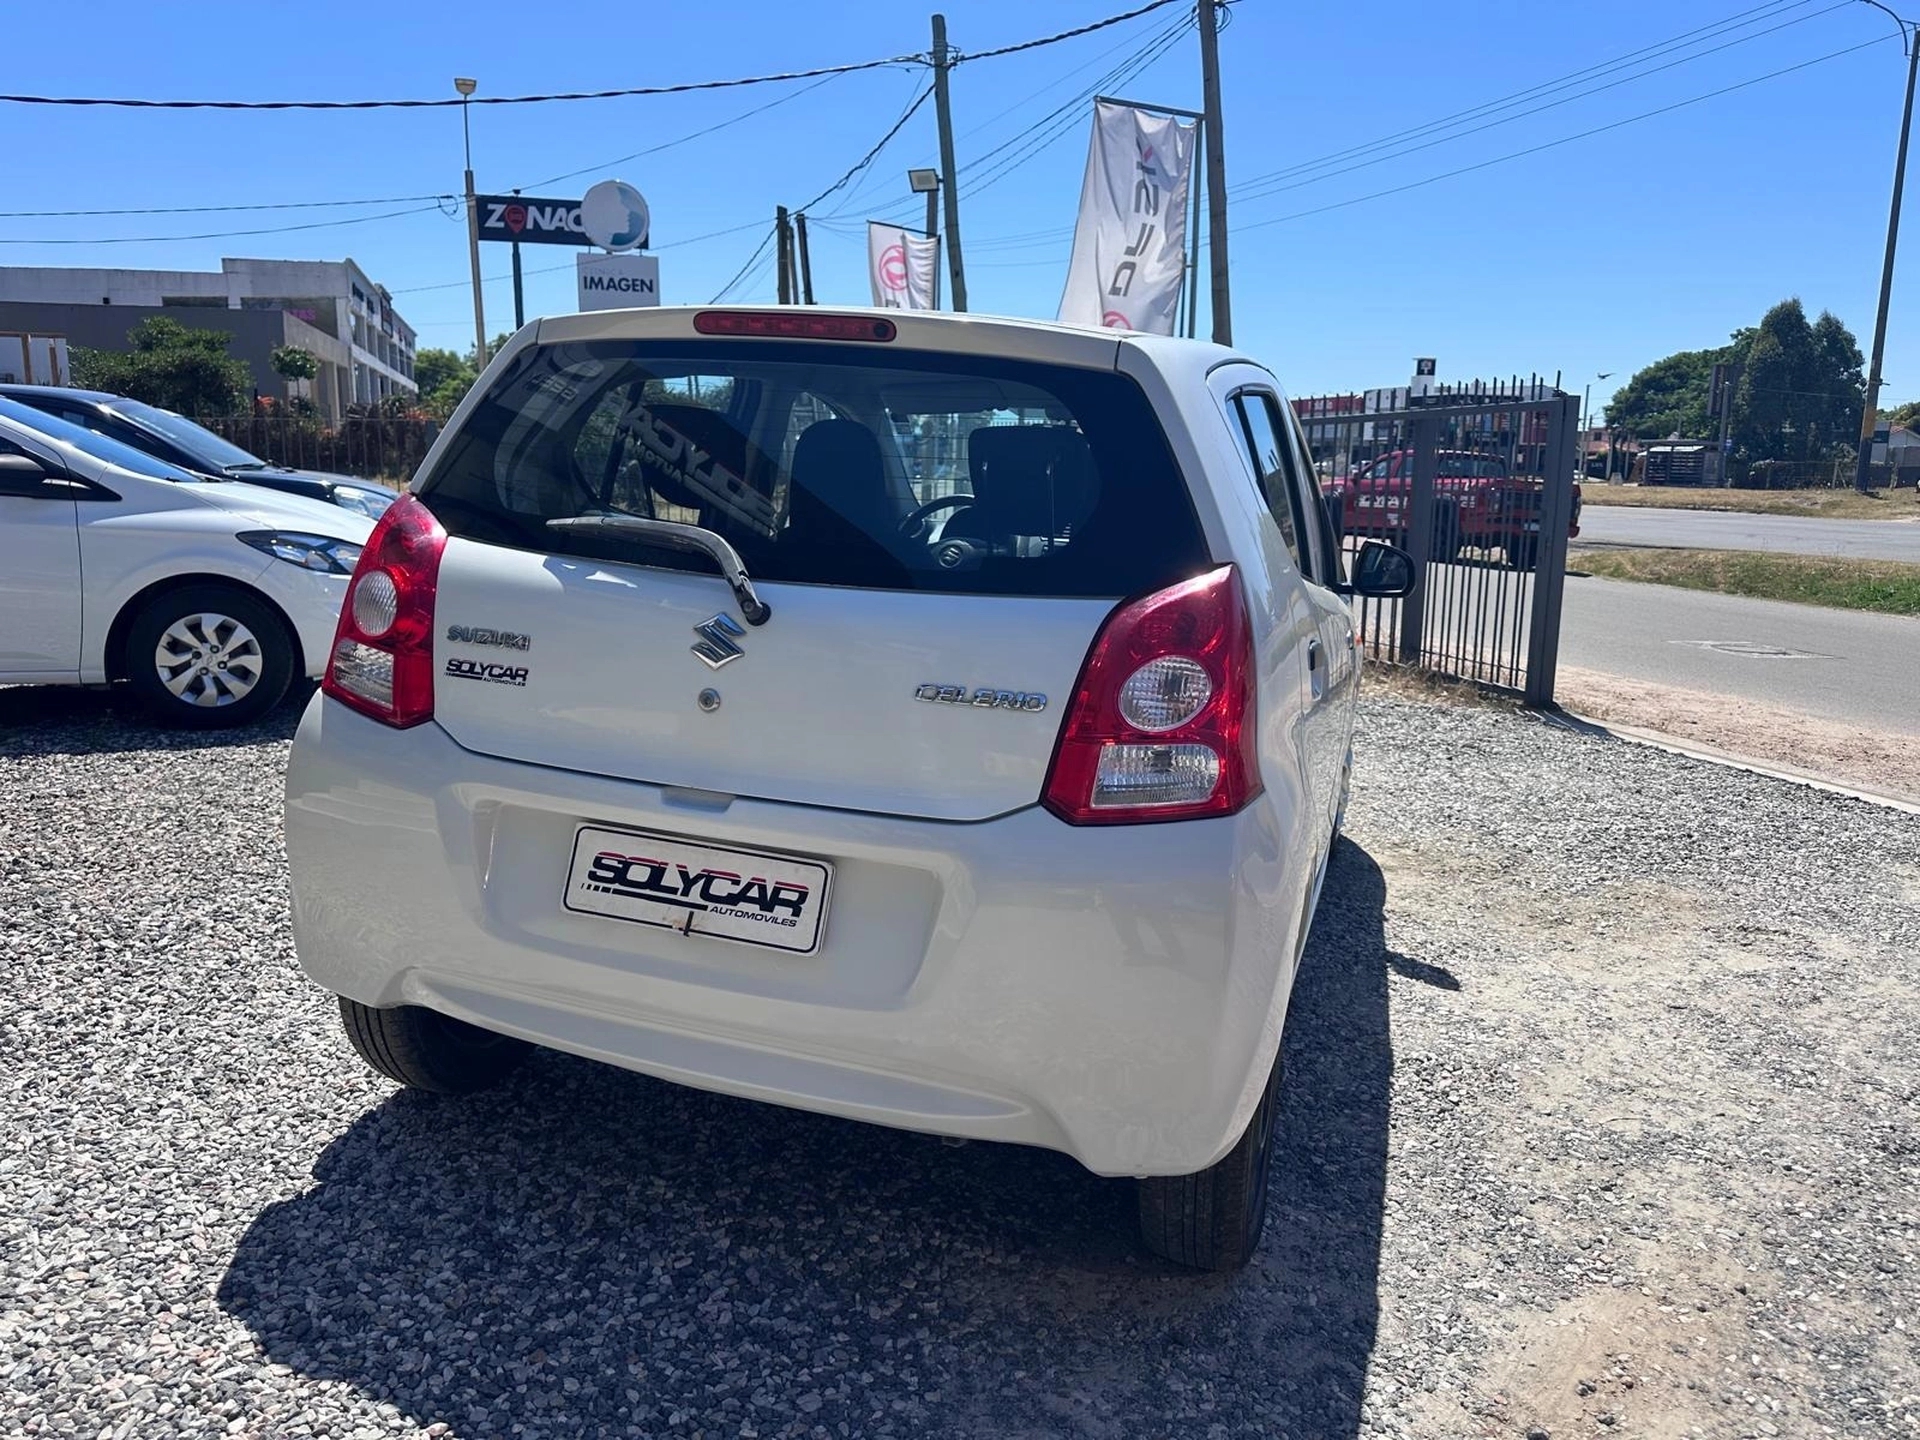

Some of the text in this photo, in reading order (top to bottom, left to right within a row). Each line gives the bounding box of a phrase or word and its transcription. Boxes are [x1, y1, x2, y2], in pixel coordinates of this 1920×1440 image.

[583, 275, 654, 293] IMAGEN
[447, 624, 531, 652] SUZUKI
[446, 658, 529, 682] SOLYCAR
[483, 677, 526, 687] AUTOMOVILES
[915, 684, 1048, 713] CELERIO
[587, 851, 810, 918] SOLYCAR
[709, 905, 798, 928] AUTOMOVILES
